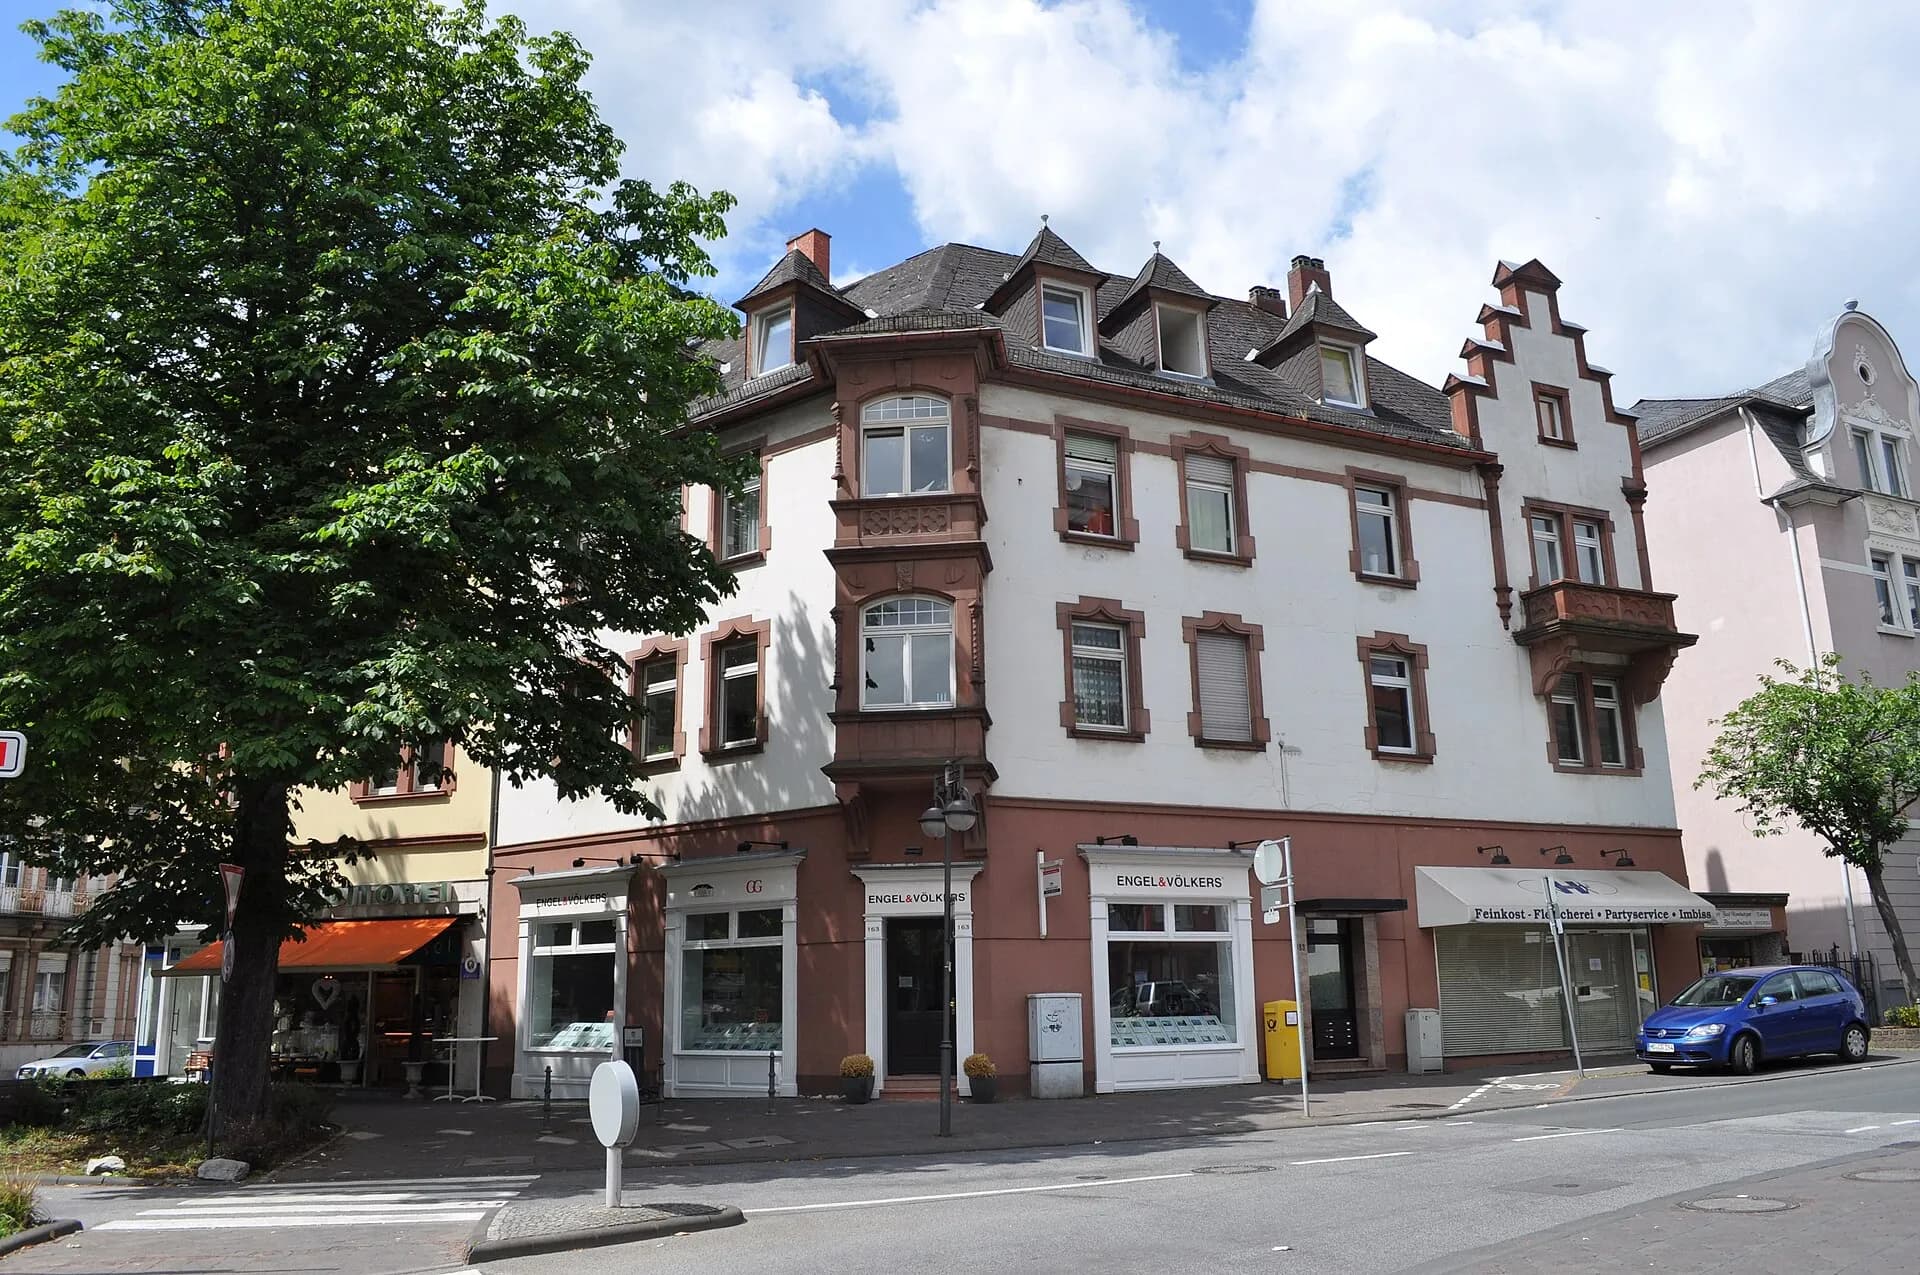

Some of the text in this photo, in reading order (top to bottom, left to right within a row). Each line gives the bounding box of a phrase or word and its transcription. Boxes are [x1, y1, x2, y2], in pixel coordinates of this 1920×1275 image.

[1117, 875, 1222, 888] ENGEL&VÖLKERS
[868, 891, 966, 904] ENGEL&VÖLKRS
[1475, 908, 1526, 919] Feinkost
[1533, 908, 1595, 920] Flecherei
[1605, 909, 1669, 922] Partyservice
[1679, 909, 1712, 919] Imbiss
